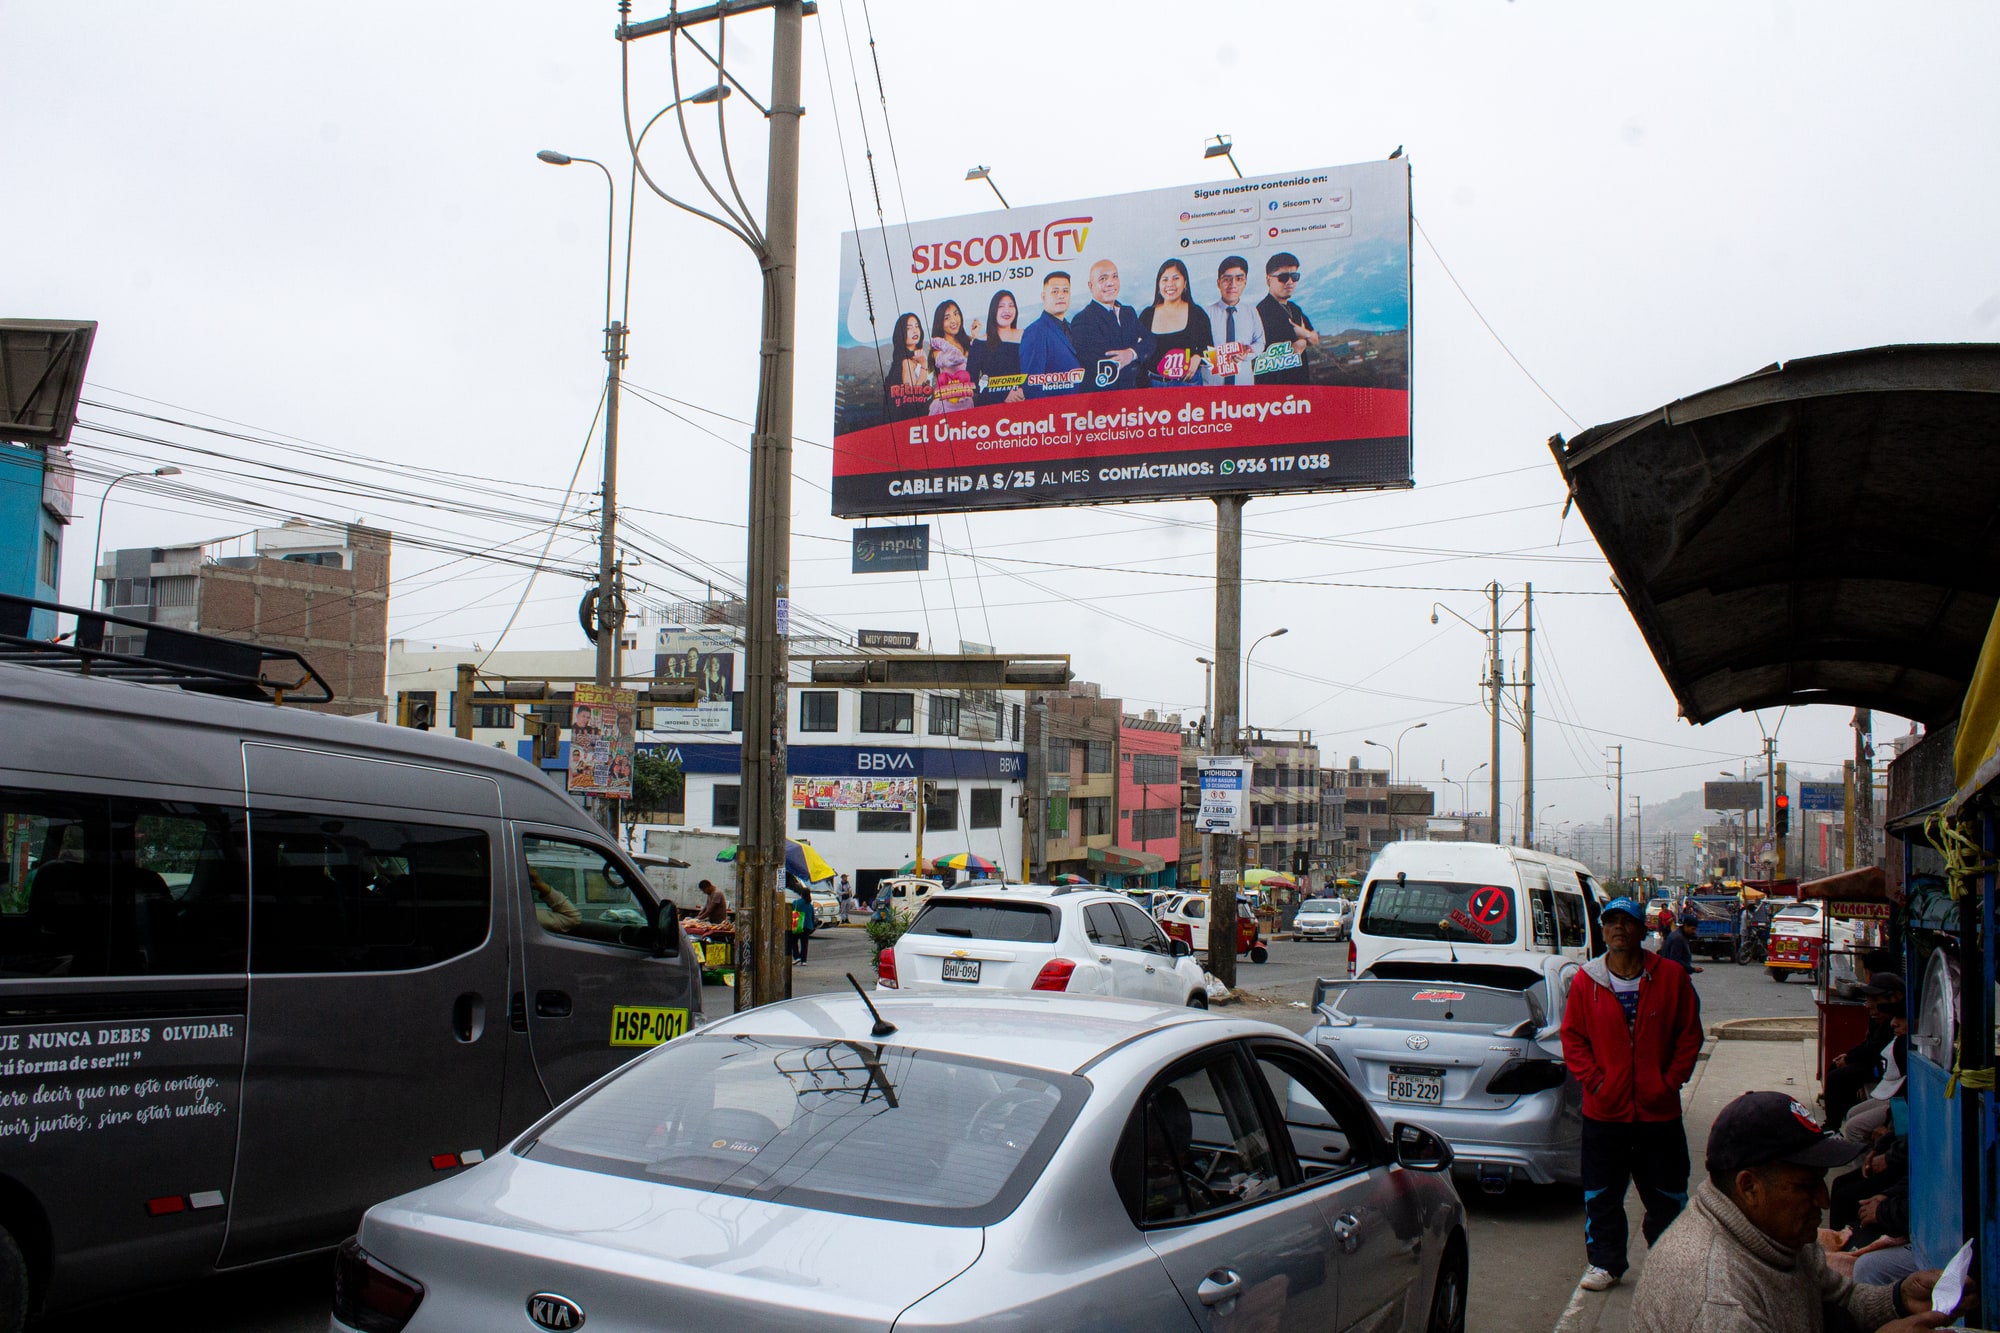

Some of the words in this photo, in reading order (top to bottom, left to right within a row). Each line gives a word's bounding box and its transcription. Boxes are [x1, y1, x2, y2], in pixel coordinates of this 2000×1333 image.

[1194, 188, 1221, 200] Sigue
[1222, 184, 1260, 195] nuestro
[1261, 176, 1310, 190] contenido
[1312, 175, 1328, 184] en:
[1282, 200, 1311, 208] Siscom
[912, 229, 1041, 274] SISCOM
[1054, 227, 1089, 255] TV
[915, 276, 956, 292] CANAL
[960, 266, 1034, 286] 28.1HD/3SD
[1216, 342, 1240, 356] FUERA
[1218, 355, 1228, 365] DE
[1218, 364, 1236, 374] LIGA
[1256, 354, 1300, 374] BANCA
[989, 376, 1022, 386] INFORME
[1028, 373, 1068, 386] SISCOM
[1072, 372, 1082, 382] TV
[1042, 382, 1074, 391] Noticias
[909, 424, 929, 444] El
[934, 418, 990, 442] Único
[996, 414, 1056, 437] Canal
[1061, 406, 1172, 432] Televisivo
[1177, 402, 1205, 423] de
[1210, 394, 1312, 422] Huaycán
[976, 432, 1038, 451] contenido
[1042, 432, 1072, 446] local
[1075, 434, 1082, 446] y
[1086, 426, 1144, 442] exclusivo
[1148, 428, 1157, 438] a
[1160, 426, 1174, 437] tu
[1178, 422, 1232, 435] alcance
[1098, 461, 1214, 482] CONTÁCTANOS:
[1236, 458, 1267, 473] 936
[1270, 456, 1295, 472] 117
[1298, 454, 1330, 470] 038
[888, 477, 944, 497] CABLE
[947, 476, 973, 494] HD
[976, 474, 990, 491] A
[992, 470, 1036, 490] S/25
[1040, 472, 1058, 485] AL
[1062, 469, 1090, 484] MES
[880, 536, 922, 554] input
[866, 634, 881, 644] MUY
[575, 692, 610, 704] REAL
[614, 692, 635, 704] 28
[858, 752, 914, 770] BBVA
[1000, 757, 1020, 772] BBVA
[945, 964, 977, 978] BHV-096
[615, 1012, 682, 1040] HSP-001
[28, 1030, 92, 1049] NUNCA
[97, 1028, 150, 1045] DEBES
[162, 1024, 233, 1041] OLVIDAR:
[16, 1058, 67, 1074] forma
[69, 1056, 87, 1070] de
[32, 1084, 72, 1104] decir
[76, 1085, 106, 1110] que
[110, 1084, 130, 1097] no
[134, 1080, 161, 1097] este
[165, 1074, 219, 1100] contigo.
[1390, 1081, 1439, 1100] F8D-229
[29, 1112, 92, 1142] juntos,
[98, 1109, 133, 1129] sino
[136, 1106, 172, 1124] estar
[176, 1097, 226, 1117] unidos.
[729, 1144, 759, 1153] HELIX
[532, 1299, 571, 1327] KIA
